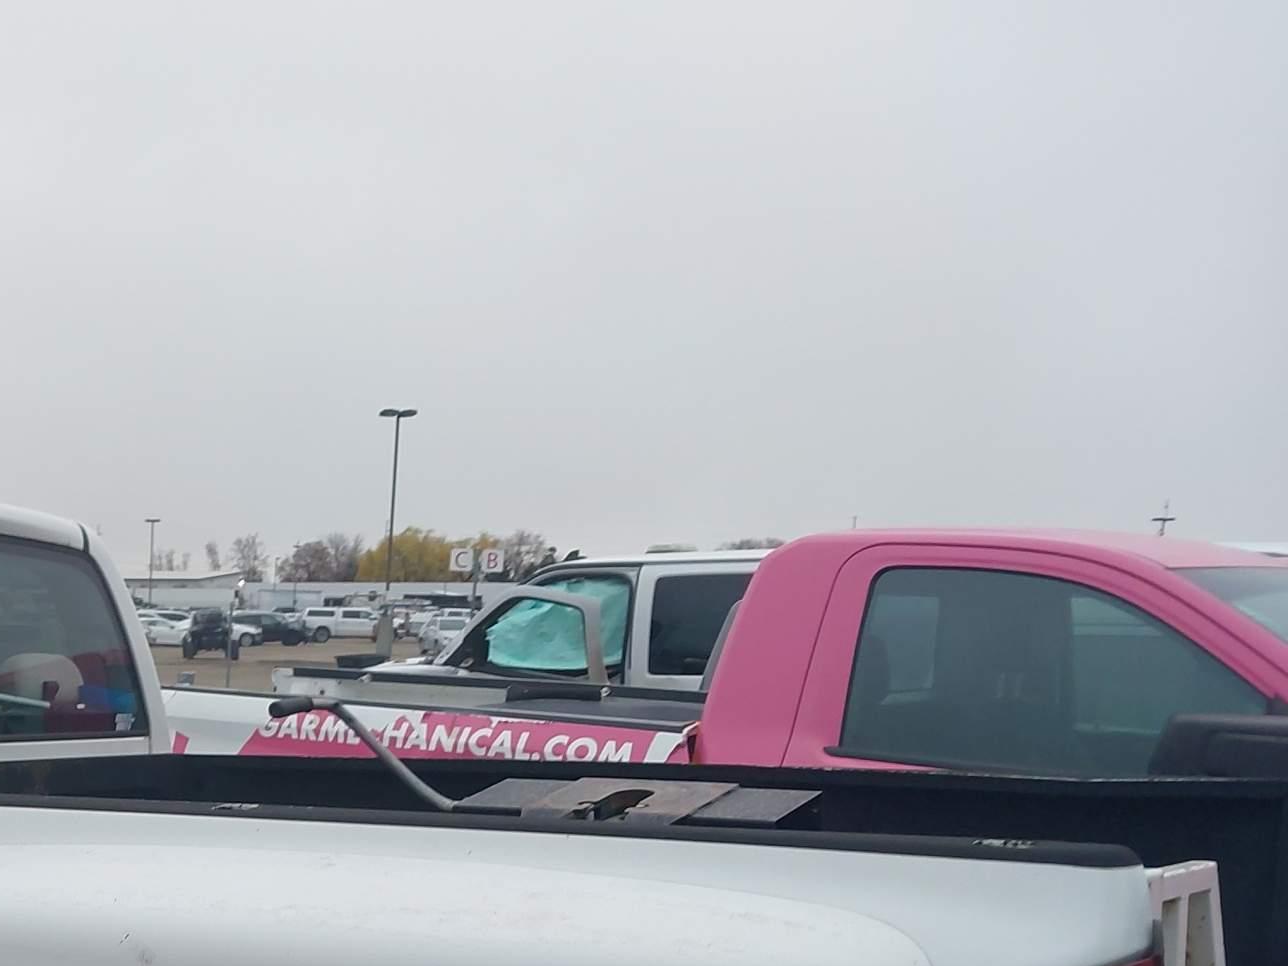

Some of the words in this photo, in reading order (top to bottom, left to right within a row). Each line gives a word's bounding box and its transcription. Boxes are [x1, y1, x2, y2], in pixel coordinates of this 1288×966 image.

[455, 551, 469, 569] C
[487, 552, 498, 569] B
[260, 711, 633, 763] GARMHANICAL.COM
